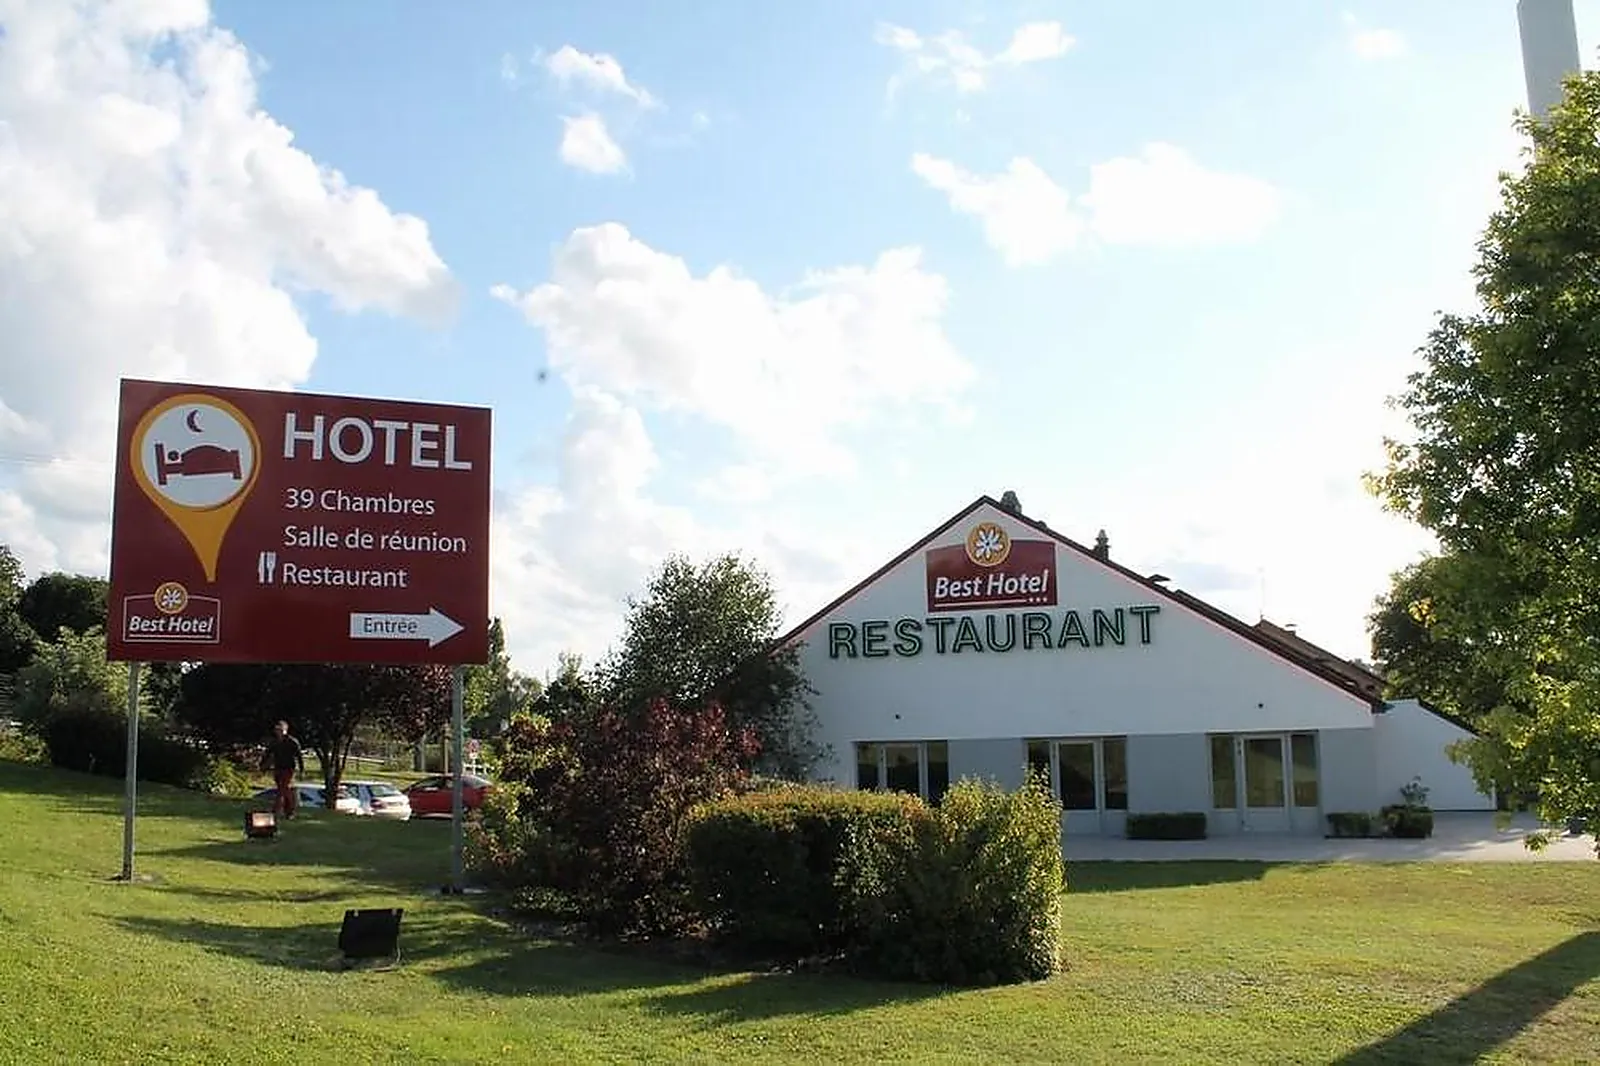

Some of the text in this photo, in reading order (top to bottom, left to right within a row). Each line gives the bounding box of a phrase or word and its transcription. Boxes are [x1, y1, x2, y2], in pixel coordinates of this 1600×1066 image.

[283, 413, 472, 471] HOTEL
[285, 488, 435, 515] 39 Chambres
[284, 526, 466, 552] Salle de réunion
[282, 563, 408, 588] Restaurant
[934, 569, 1049, 599] Best Hotel
[129, 615, 213, 633] Best Hotel
[828, 605, 1160, 659] RESTAURANT
